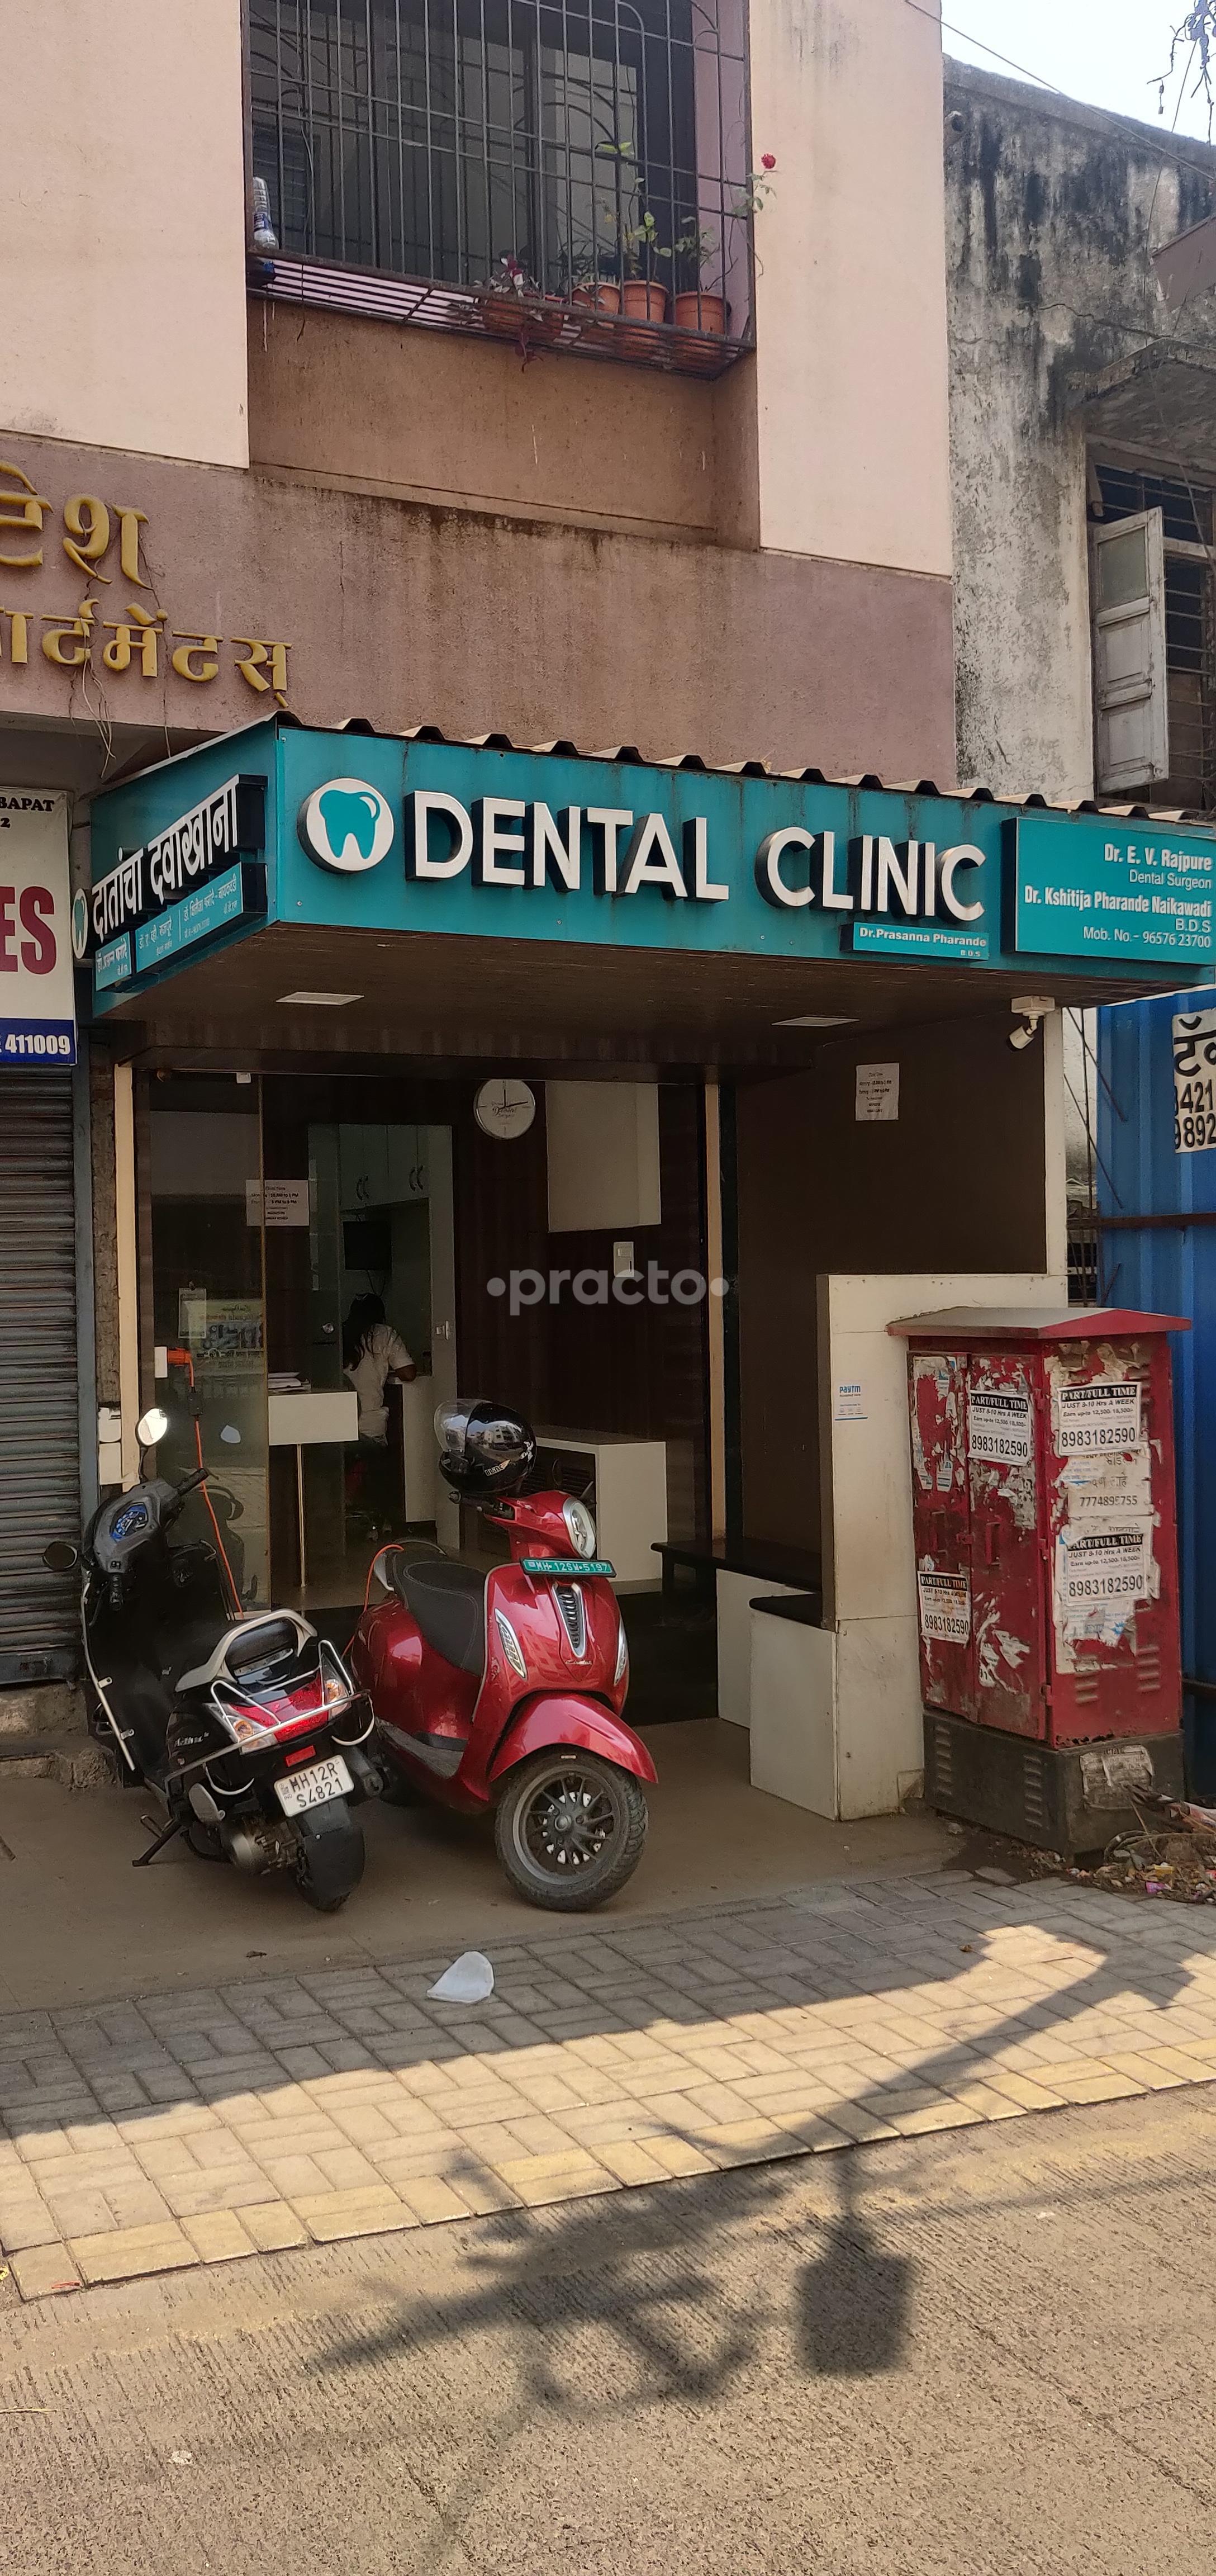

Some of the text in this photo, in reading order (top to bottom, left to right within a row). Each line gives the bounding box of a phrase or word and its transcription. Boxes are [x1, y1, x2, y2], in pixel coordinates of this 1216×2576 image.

[92, 773, 240, 945] दातांचा दवाखाना
[412, 789, 987, 922] DENTAL CLINIC
[1104, 843, 1212, 873] Dr. E. V. Rajpure
[1129, 869, 1212, 891] Dental Surgeon
[1024, 885, 1212, 917] Dr. Kshitija Pharande Naikawadi
[1175, 918, 1212, 934] B.D.S
[859, 927, 987, 948] Dr.Prasanna Pharande
[1083, 926, 1111, 941] Mob.
[1142, 931, 1176, 946] 96576
[1177, 934, 1212, 949] 23700
[5, 1034, 71, 1055] 411009
[971, 1395, 1028, 1410] PART/FULL TIME
[1062, 1386, 1137, 1401] PART/FULL TIME
[972, 1434, 1028, 1457] 8983182590
[1062, 1427, 1136, 1447] 8983182590
[1068, 1534, 1142, 1550] ART/FULL TIME
[952, 1579, 967, 1590] TIME
[1068, 1574, 1143, 1597] 8983182590
[924, 1614, 970, 1635] 8983182590
[288, 1762, 338, 1793] MH12R
[296, 1777, 344, 1808] S4821
